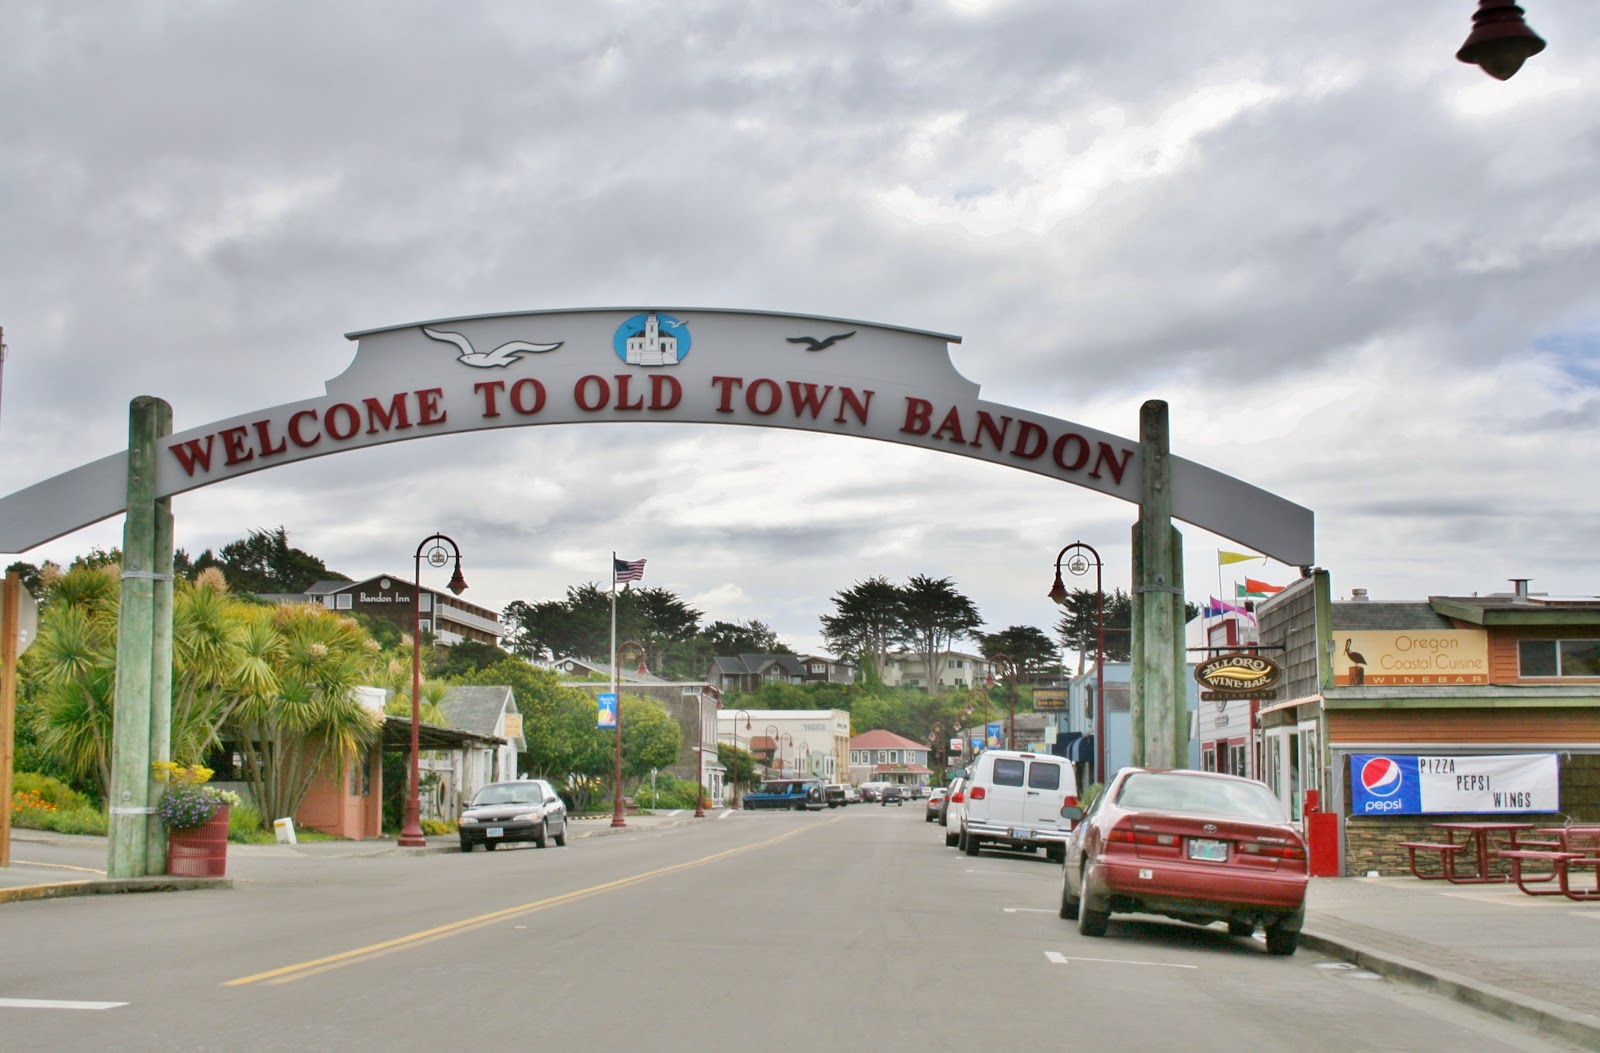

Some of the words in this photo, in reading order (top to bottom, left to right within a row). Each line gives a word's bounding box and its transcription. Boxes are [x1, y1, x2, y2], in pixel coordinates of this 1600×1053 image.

[168, 387, 447, 477] WELCOME
[474, 377, 546, 418] TO
[574, 374, 682, 411] OLD
[711, 376, 875, 426] TOWN
[899, 396, 1134, 485] BANDON
[360, 592, 392, 603] Bandon
[395, 592, 410, 603] Inn
[1395, 635, 1458, 653] Oregon
[1202, 657, 1265, 675] ALLORO
[1380, 654, 1432, 670] Coastal
[1435, 653, 1483, 670] Cuisine
[1420, 758, 1455, 774] PIZZA
[1457, 775, 1490, 791] PEPSI
[1365, 799, 1402, 812] pepsi
[1493, 792, 1531, 808] WINGS
